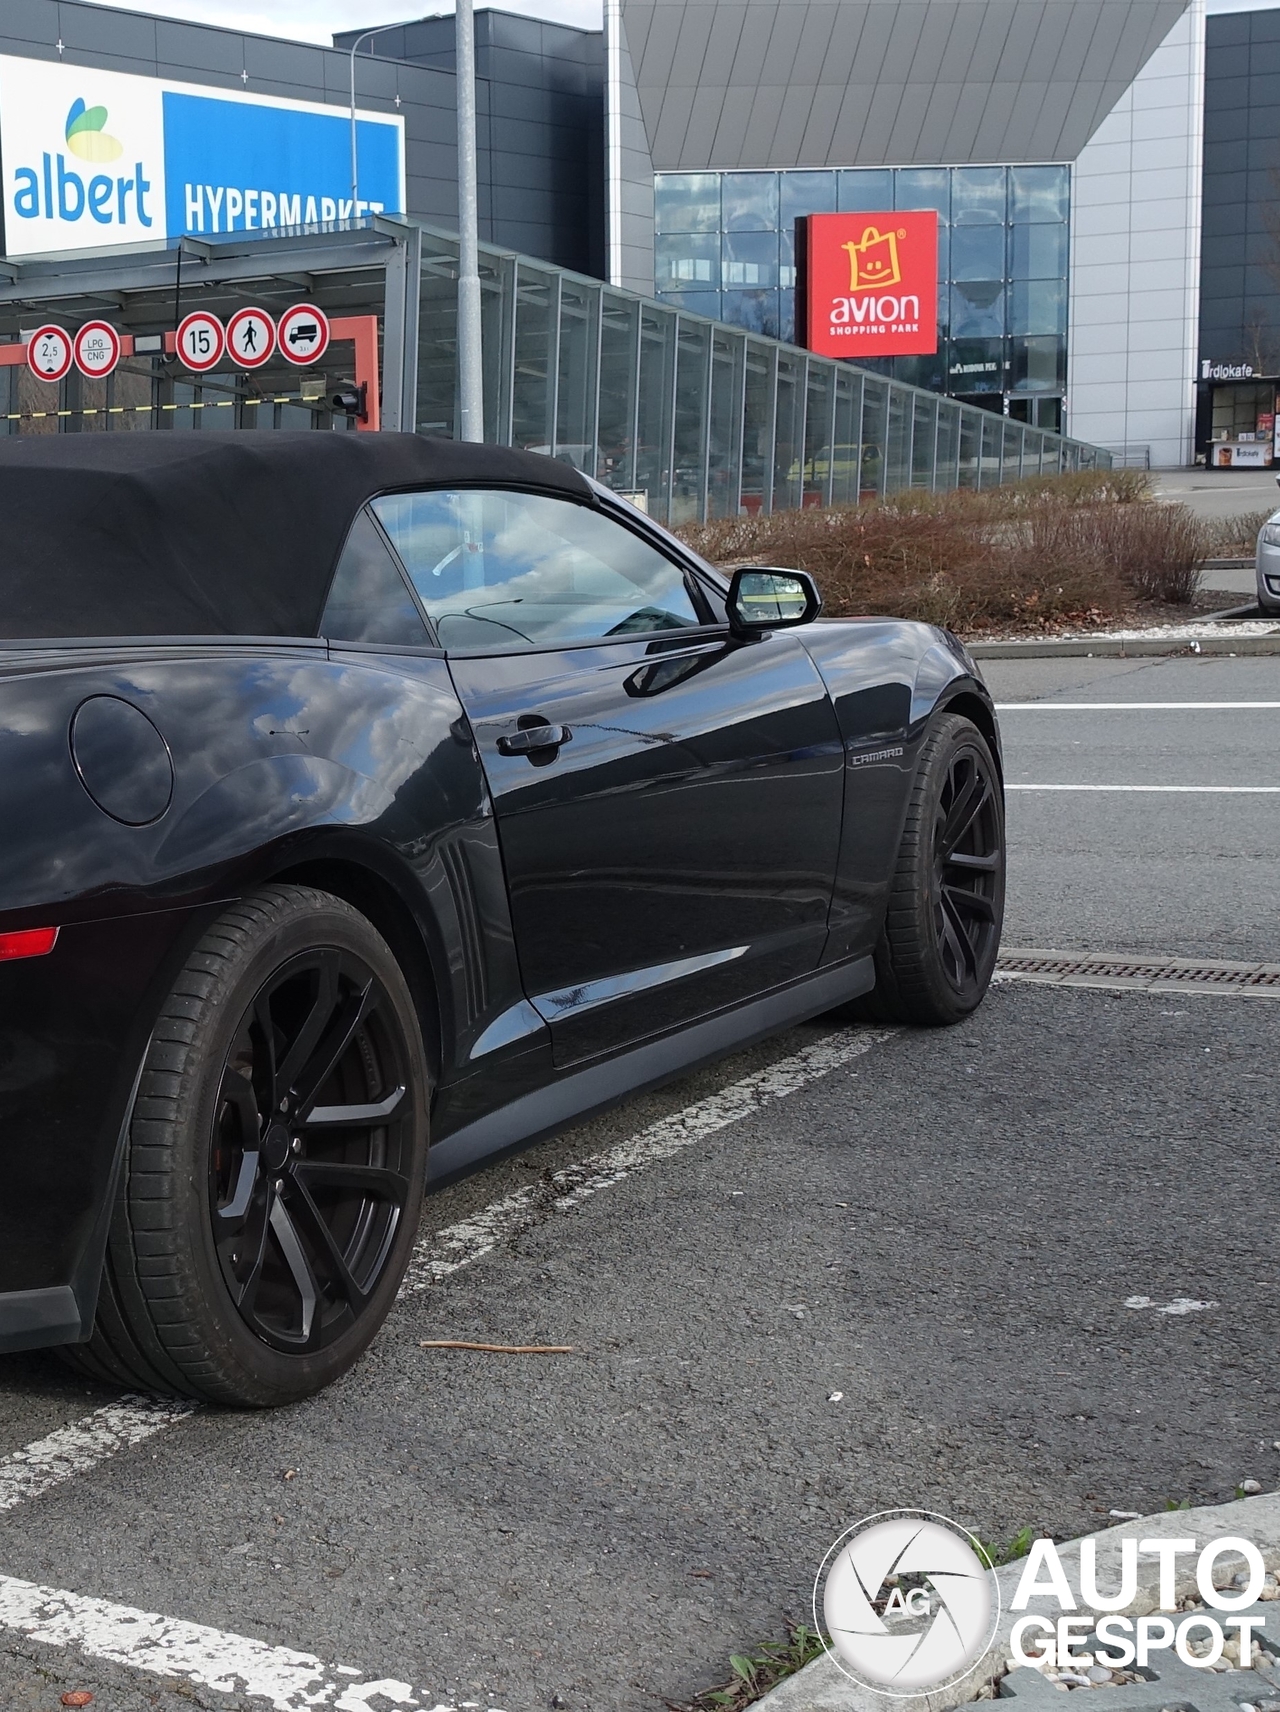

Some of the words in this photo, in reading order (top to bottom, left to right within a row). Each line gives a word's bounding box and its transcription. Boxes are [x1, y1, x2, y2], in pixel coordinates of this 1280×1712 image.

[13, 150, 153, 228] albert
[829, 295, 919, 324] avion
[829, 325, 886, 336] SHOPPING
[891, 323, 919, 333] PARK
[88, 339, 103, 348] LPG
[189, 329, 210, 354] 15
[42, 343, 58, 357] 2,5
[88, 351, 104, 361] CNG
[852, 747, 903, 765] CAMARO
